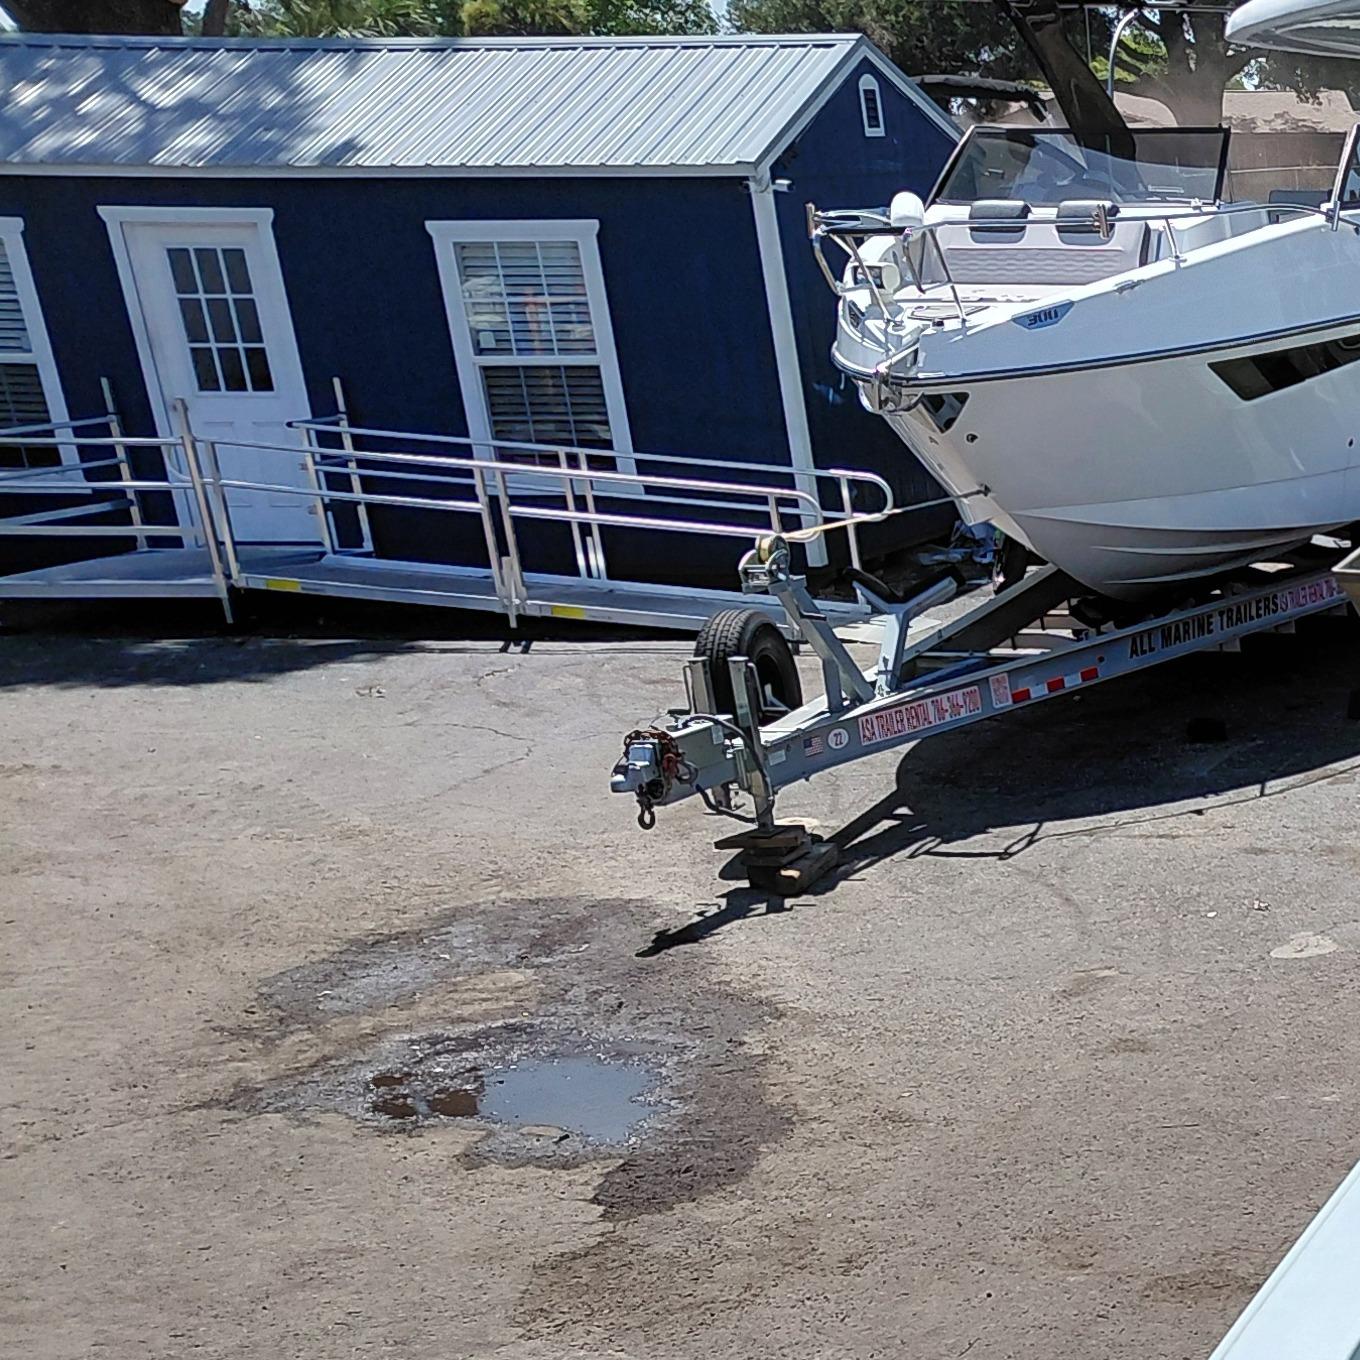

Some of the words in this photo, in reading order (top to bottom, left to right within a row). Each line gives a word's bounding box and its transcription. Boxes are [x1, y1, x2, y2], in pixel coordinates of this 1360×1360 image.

[1027, 309, 1059, 326] 300
[1129, 636, 1156, 659] ALL
[1161, 615, 1214, 649] MARINE
[1218, 594, 1279, 632] TRAILERS
